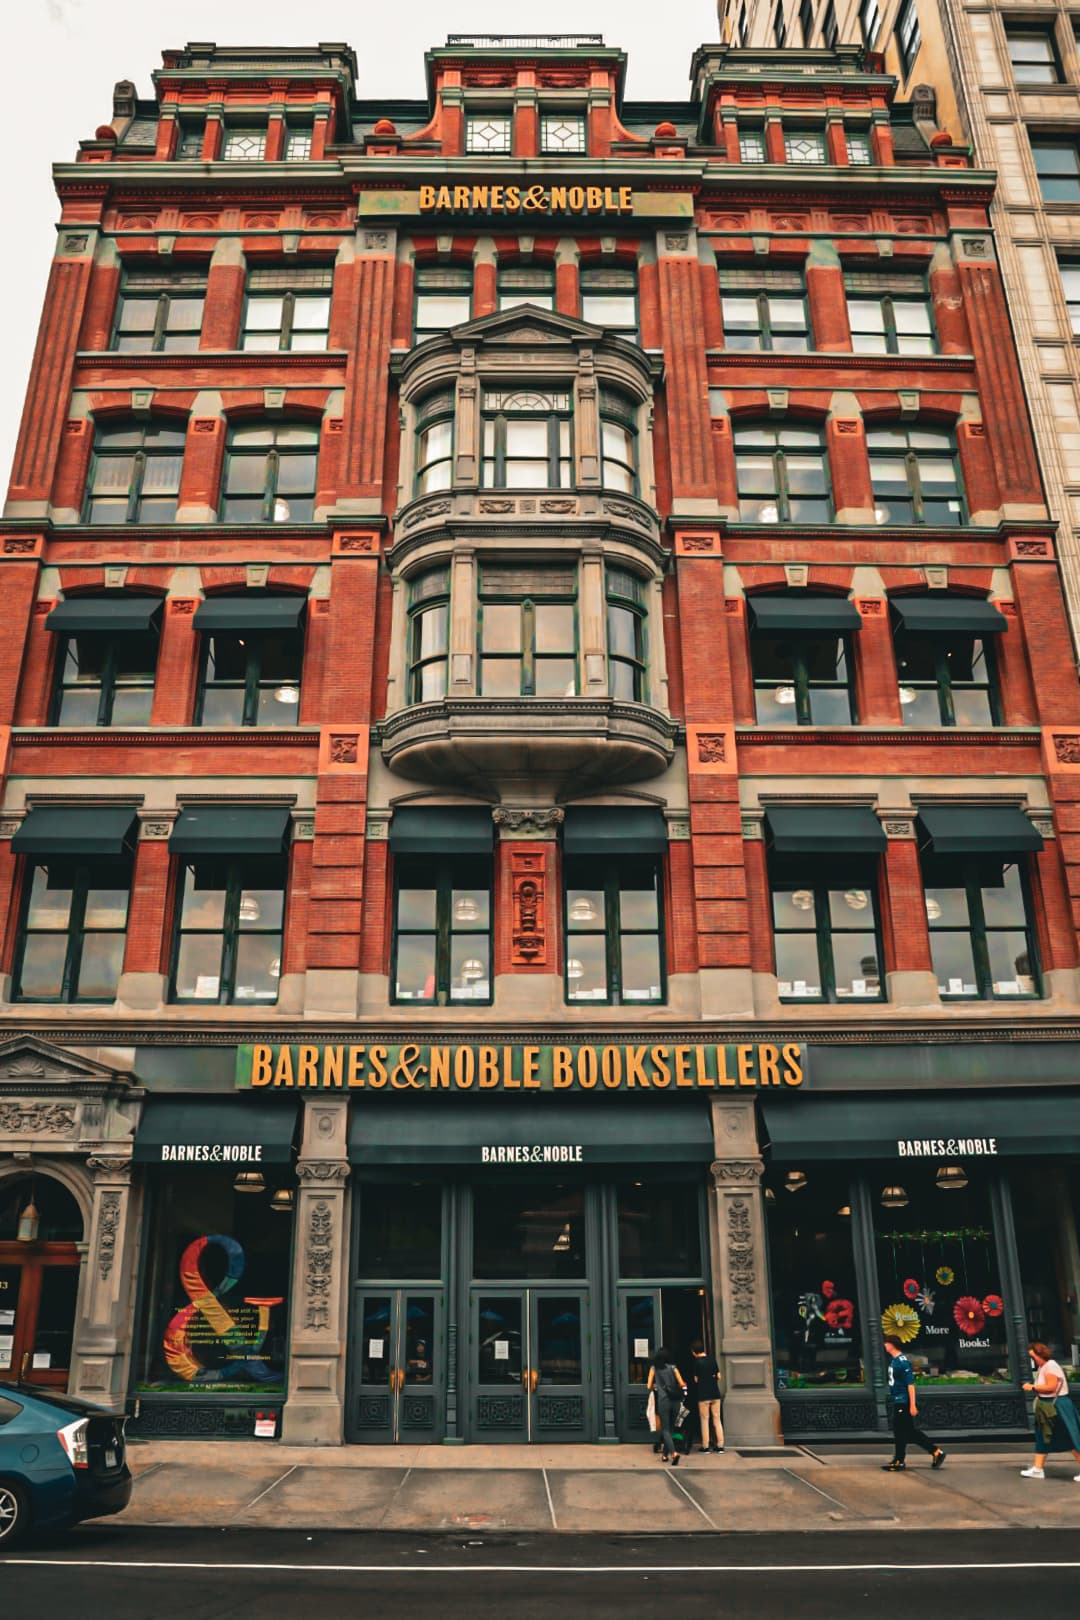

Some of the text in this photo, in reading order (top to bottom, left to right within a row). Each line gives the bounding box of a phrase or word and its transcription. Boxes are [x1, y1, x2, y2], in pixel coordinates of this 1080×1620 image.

[420, 185, 633, 210] BARNES&NOBLE
[251, 1043, 804, 1089] BARNES&NOBLE BOOKSELLERS
[161, 1144, 262, 1162] BARNES&NOBLE
[481, 1145, 583, 1163] BARNES&NOBLE
[898, 1138, 998, 1157] BARNES&NOBLE
[925, 1325, 950, 1335] More
[958, 1338, 991, 1348] Books!
